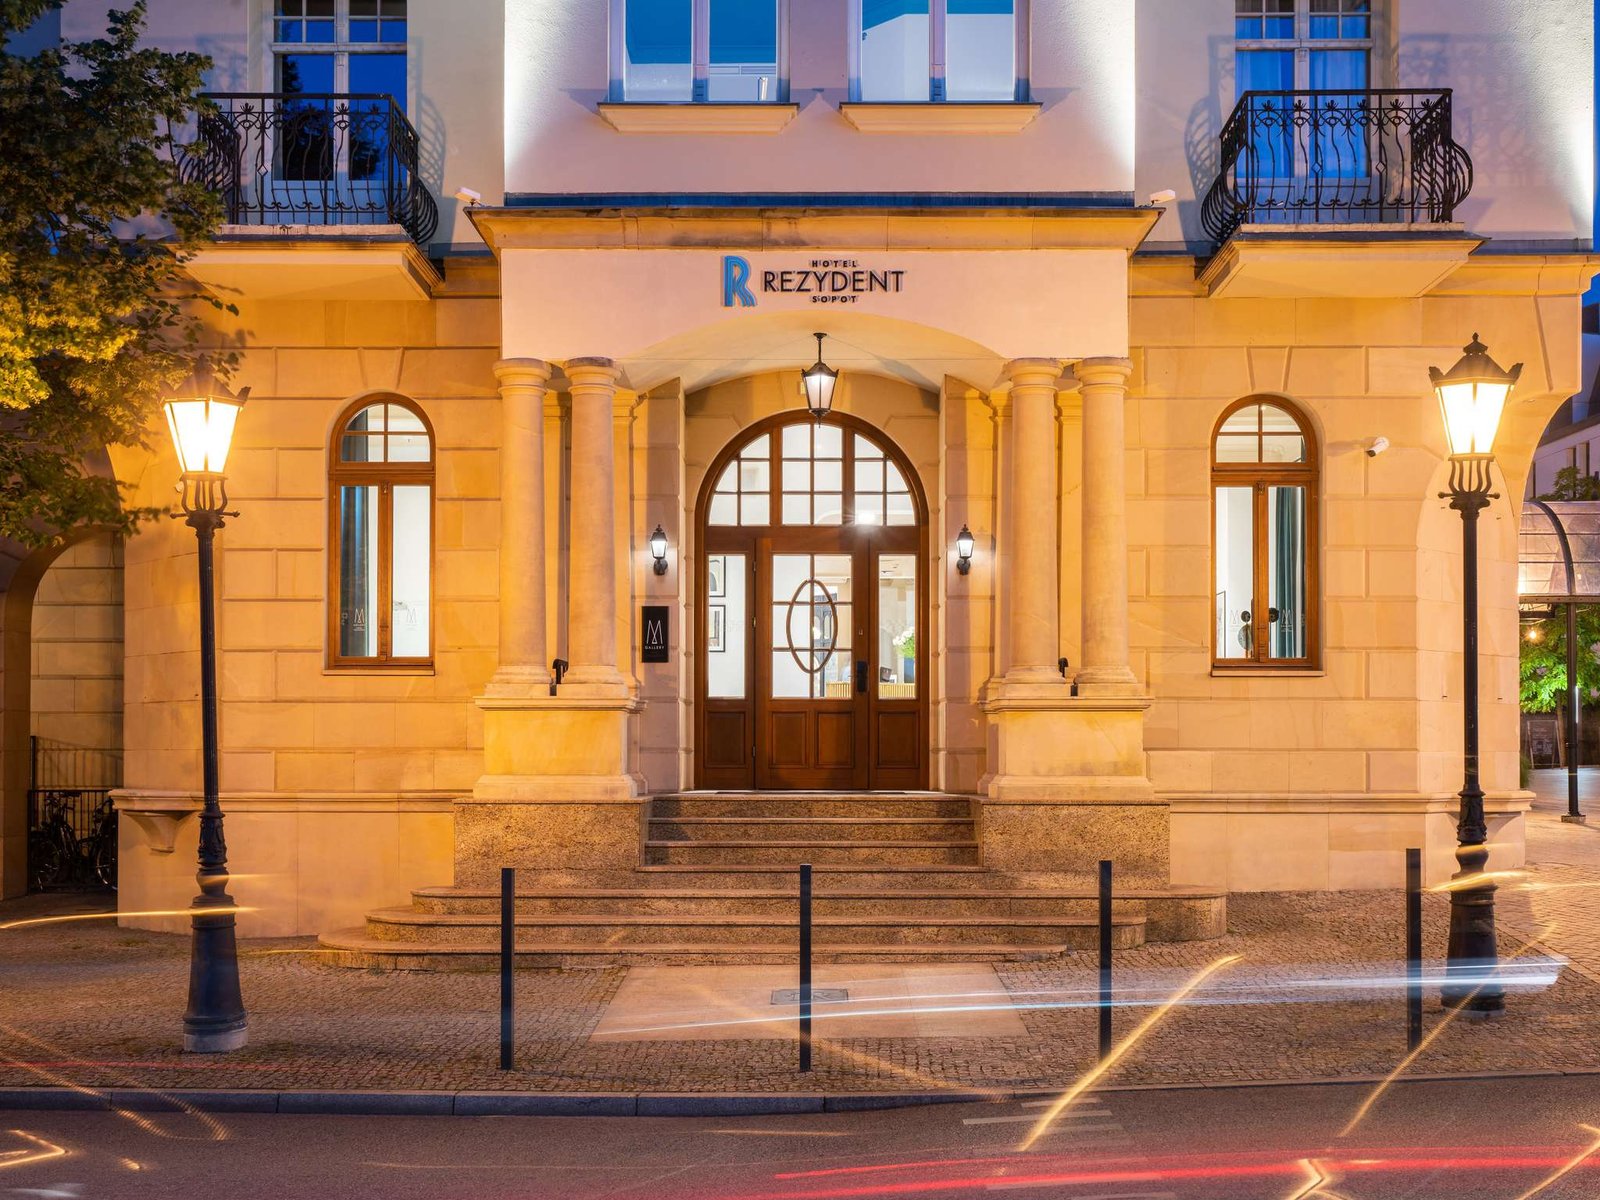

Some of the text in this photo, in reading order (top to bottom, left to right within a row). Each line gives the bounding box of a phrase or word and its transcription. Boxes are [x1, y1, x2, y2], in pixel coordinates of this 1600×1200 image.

[812, 260, 858, 268] HOTEL
[763, 271, 904, 293] REZYDENT
[812, 295, 858, 304] SOPOT
